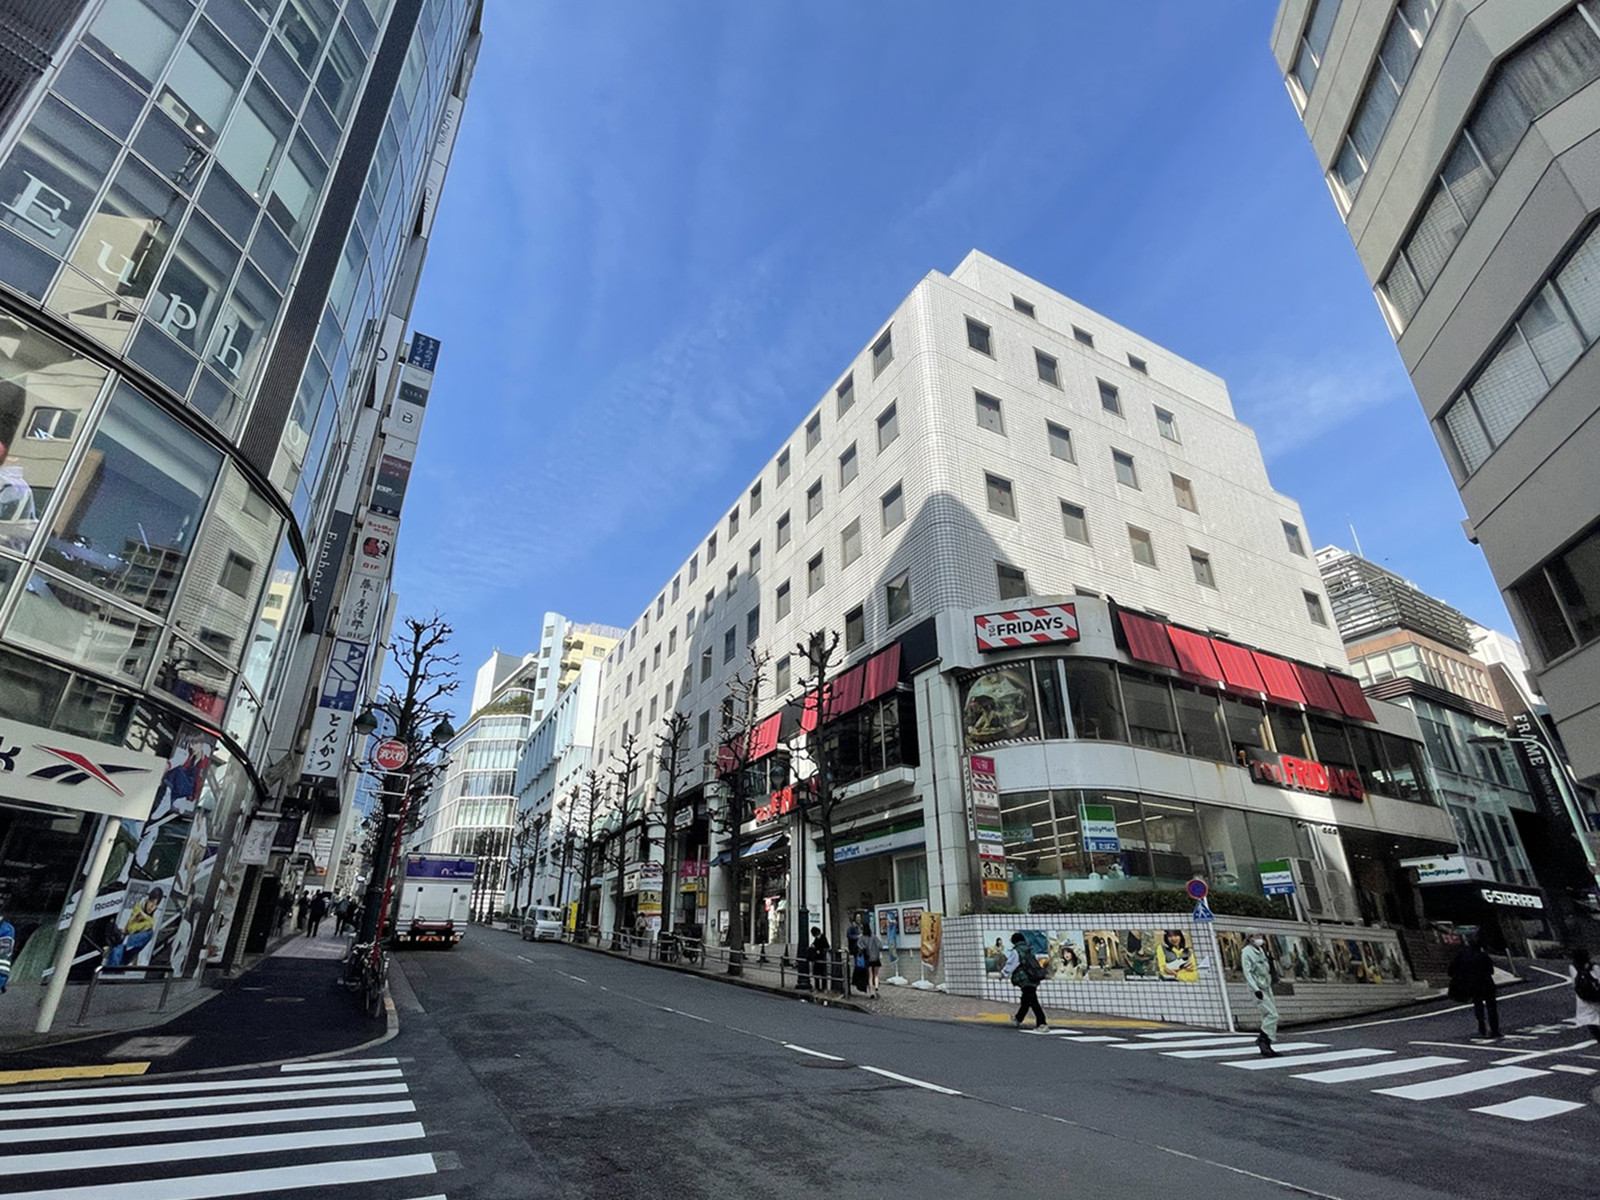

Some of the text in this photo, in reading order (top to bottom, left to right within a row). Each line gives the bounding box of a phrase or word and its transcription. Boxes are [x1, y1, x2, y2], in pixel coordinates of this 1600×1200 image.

[996, 616, 1064, 637] FRIDAYS
[317, 713, 341, 771] とんかつ
[1513, 713, 1545, 767] FRAME
[1279, 754, 1364, 800] FRIDAYS
